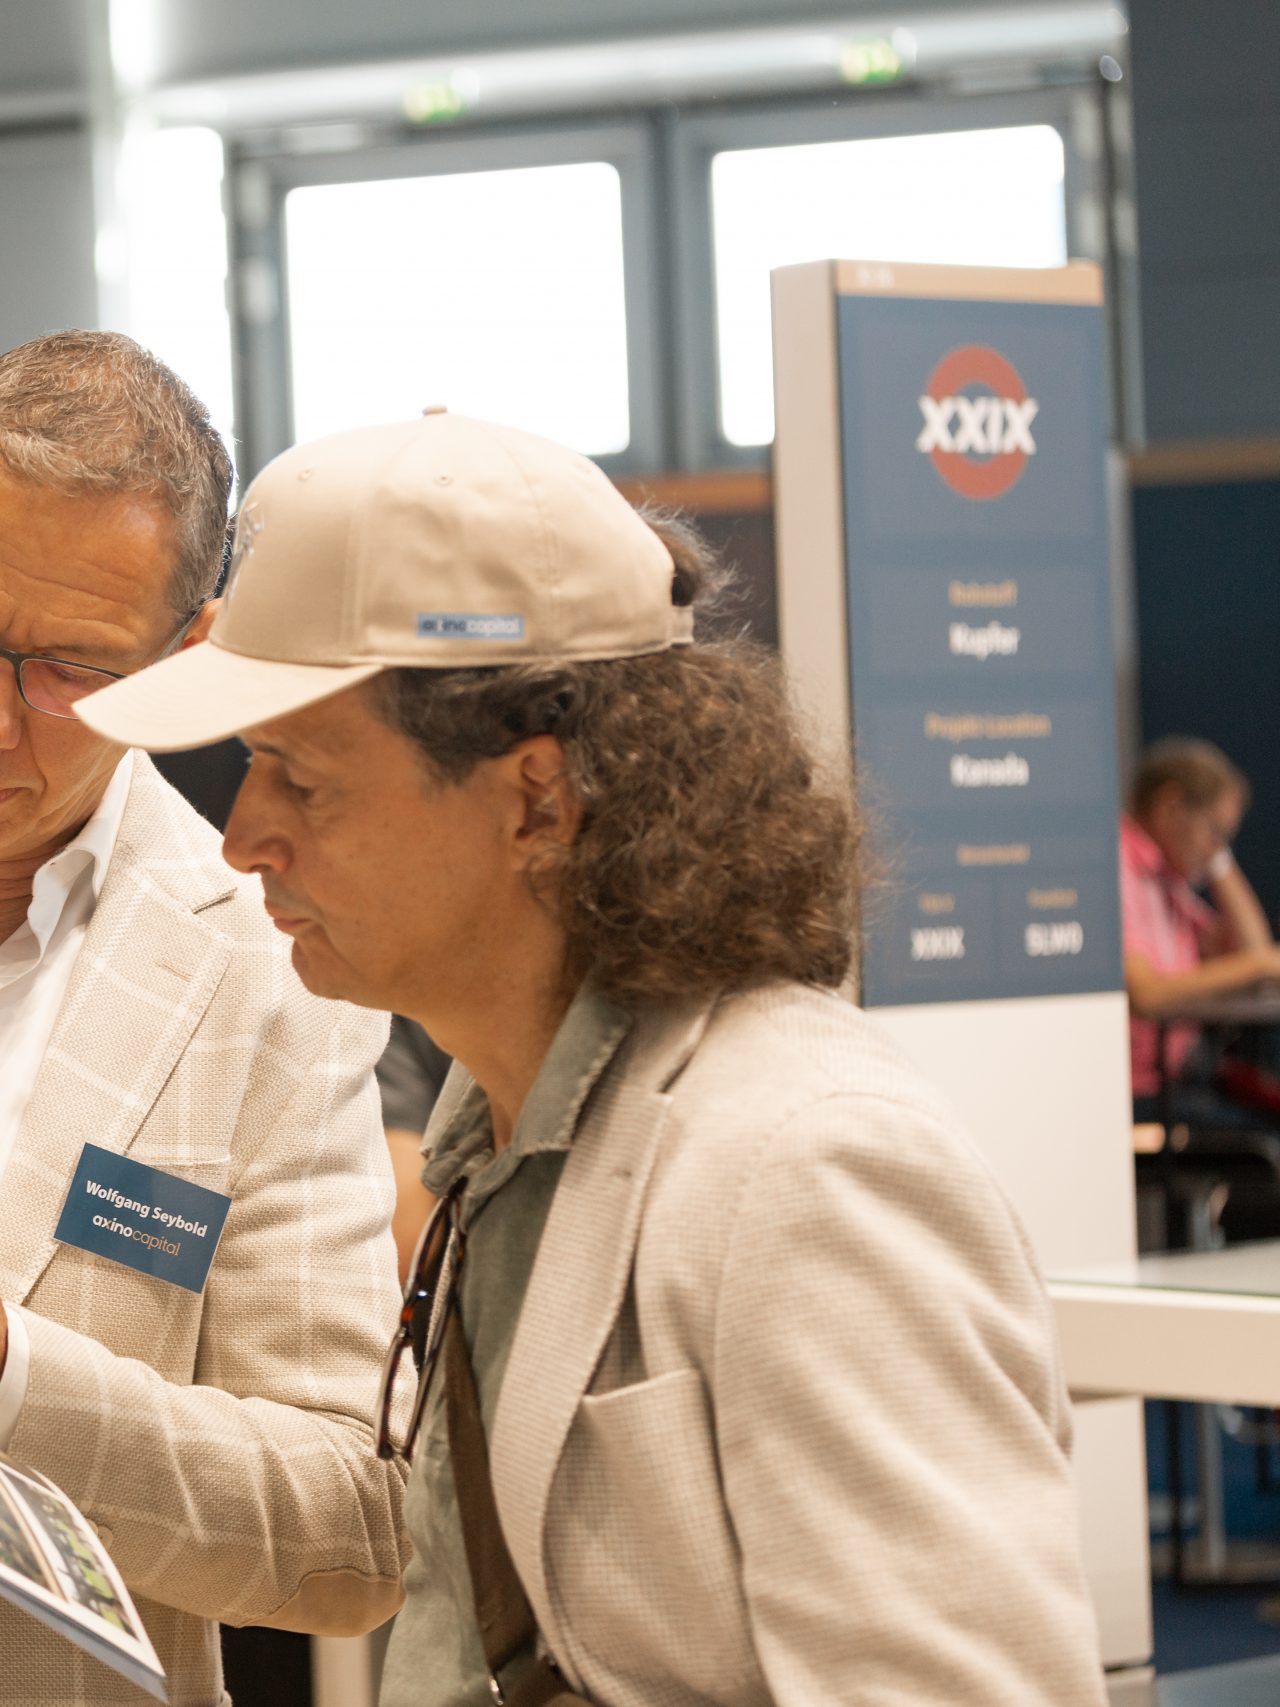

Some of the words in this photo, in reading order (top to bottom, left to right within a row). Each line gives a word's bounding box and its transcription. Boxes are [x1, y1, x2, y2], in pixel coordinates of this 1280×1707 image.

[918, 395, 1037, 454] XXIX
[86, 1180, 150, 1218] Wolfgang
[151, 1206, 208, 1238] Seybold
[92, 1213, 182, 1256] axinocapital
